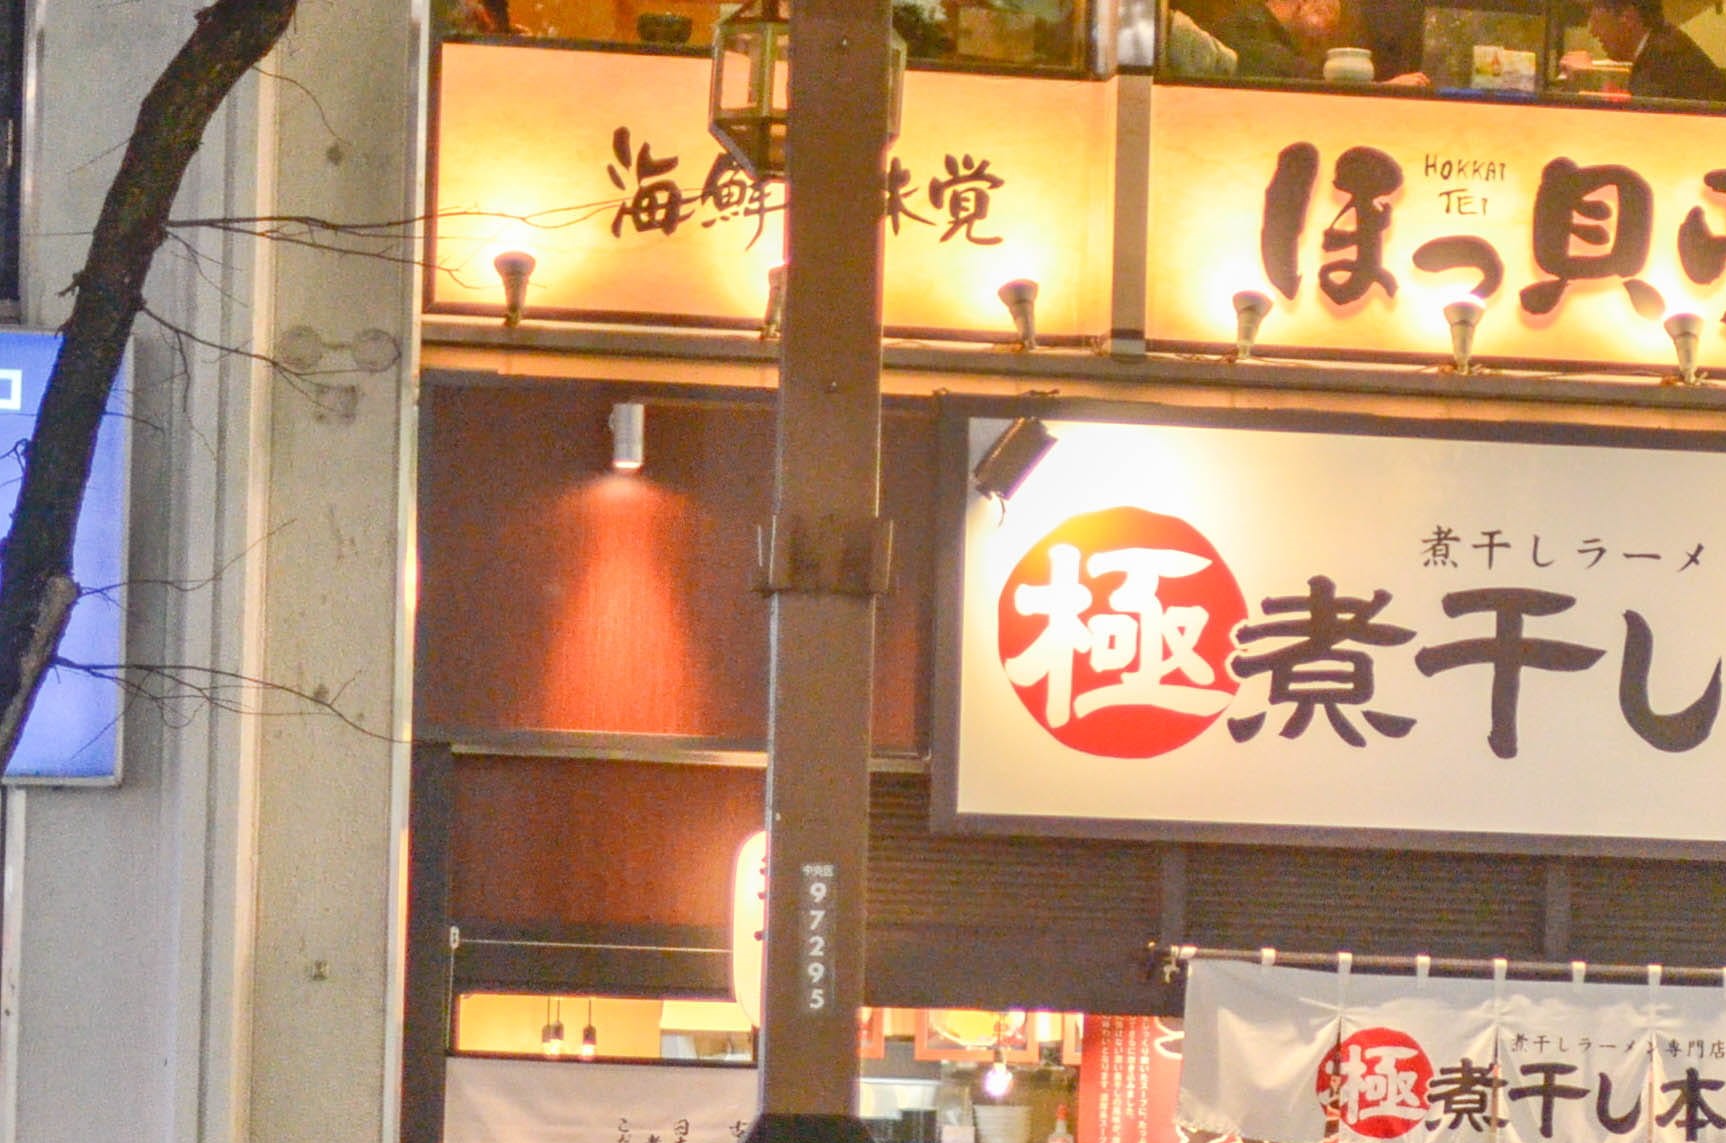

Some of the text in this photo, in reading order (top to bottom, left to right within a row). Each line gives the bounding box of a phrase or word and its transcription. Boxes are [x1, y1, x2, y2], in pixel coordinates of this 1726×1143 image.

[1424, 153, 1507, 183] HOKKAI
[1438, 189, 1489, 217] TEI
[1002, 540, 1242, 729] 極
[807, 882, 828, 1009] 97295
[1319, 1044, 1428, 1126] 極
